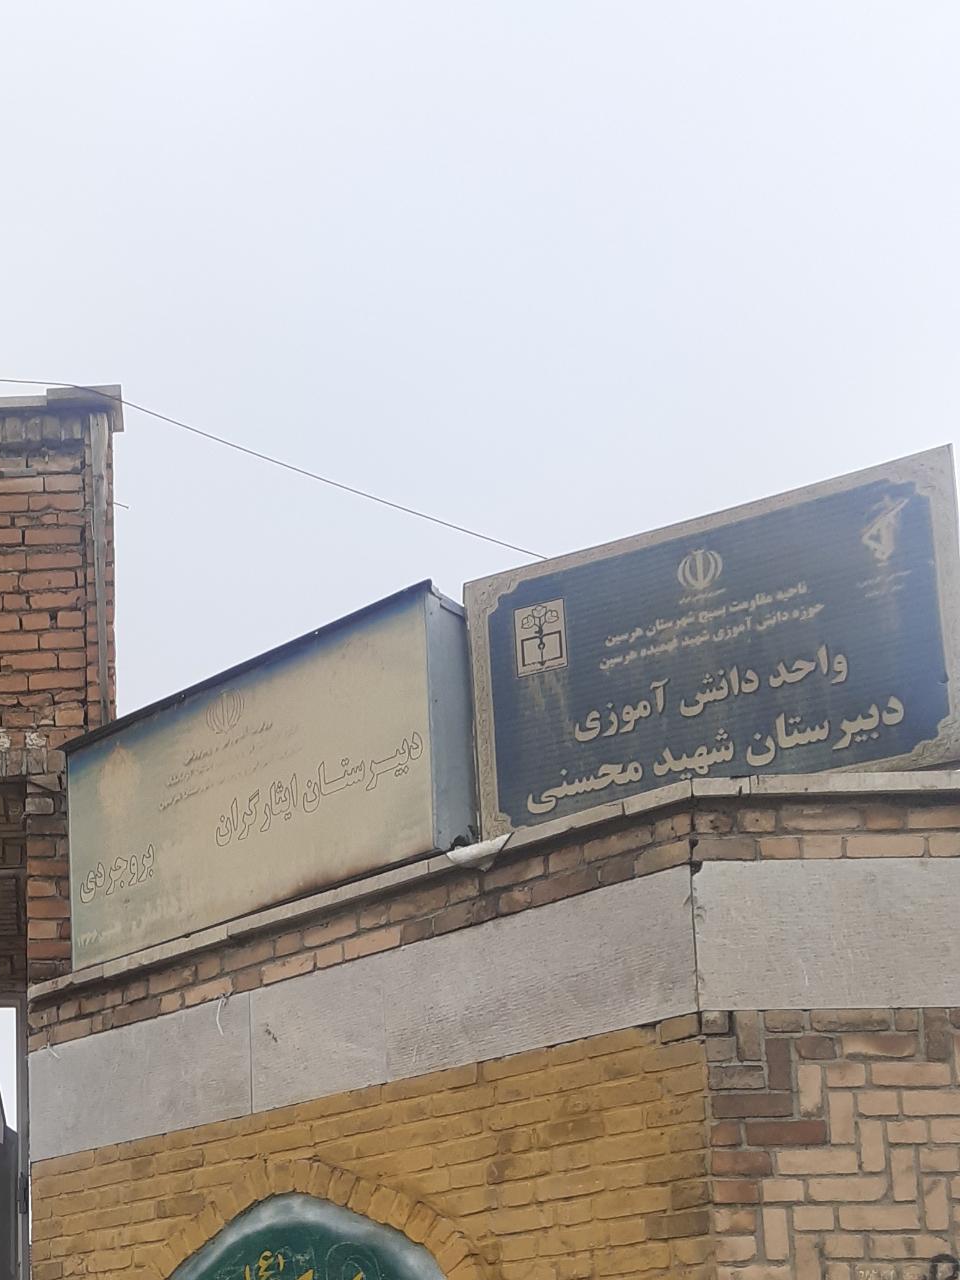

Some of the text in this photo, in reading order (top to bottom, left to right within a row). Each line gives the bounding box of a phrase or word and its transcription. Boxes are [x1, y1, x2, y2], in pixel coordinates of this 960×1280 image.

[729, 592, 773, 613] مقاومت
[792, 604, 825, 624] حوزه
[645, 611, 696, 637] شهرستان
[699, 606, 726, 623] بسیج
[756, 611, 789, 631] دانش
[605, 627, 643, 647] هرسین
[682, 630, 710, 648] شهید
[712, 616, 753, 642] آموزی
[599, 650, 638, 671] هرسین
[575, 644, 848, 741] واحد دانش آموزی
[527, 695, 904, 814] دبیرستان شهید محسنی
[303, 731, 423, 813] دبیرستان
[215, 772, 298, 847] ایثارگران
[80, 844, 155, 904] بروجردی
